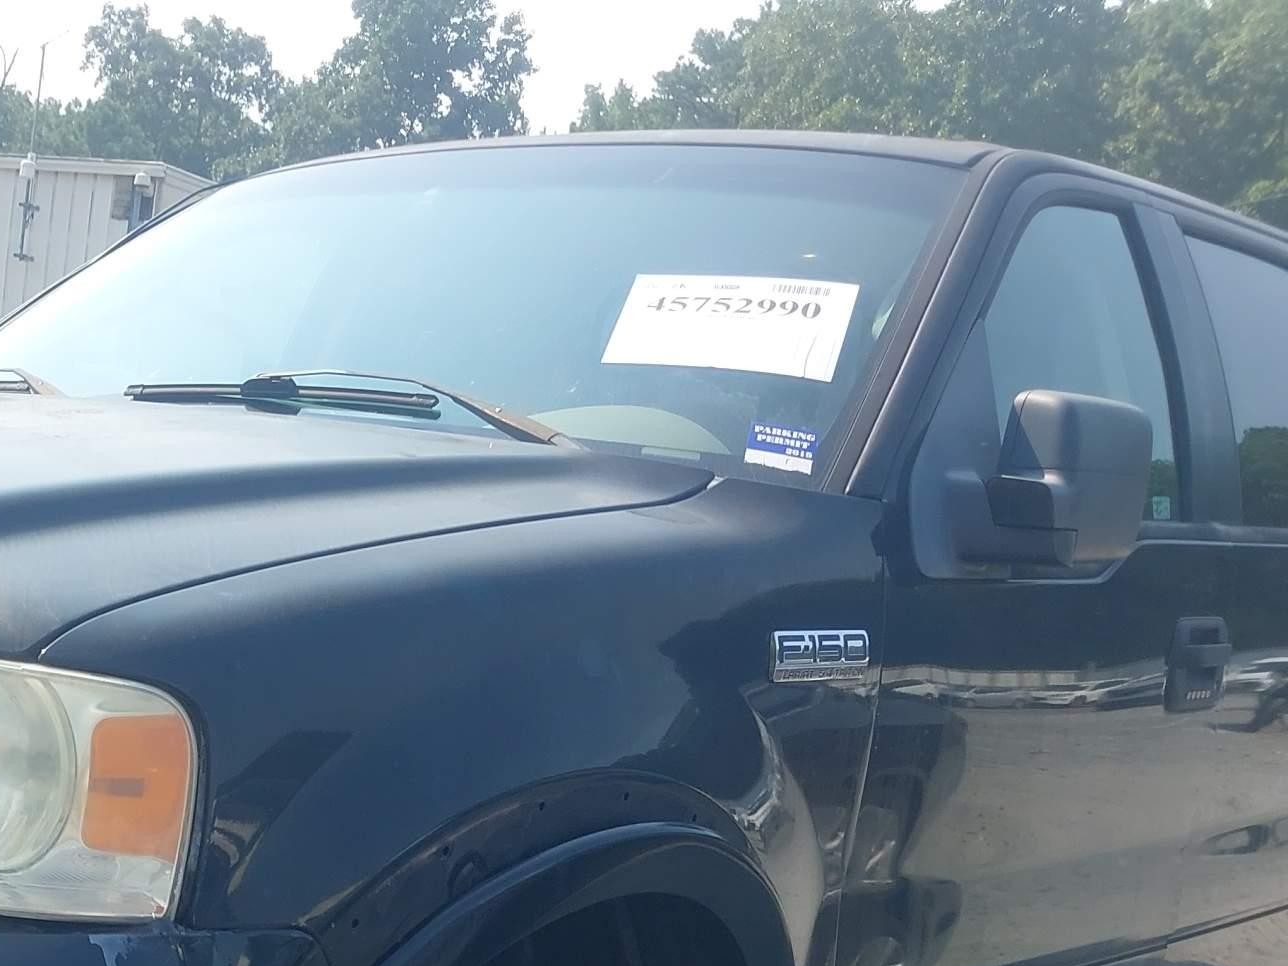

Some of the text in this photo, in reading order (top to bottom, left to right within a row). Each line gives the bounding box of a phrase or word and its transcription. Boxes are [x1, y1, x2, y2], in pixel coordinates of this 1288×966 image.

[647, 296, 822, 320] 45752990
[754, 424, 816, 442] PARKING
[756, 433, 811, 450] PERMIT
